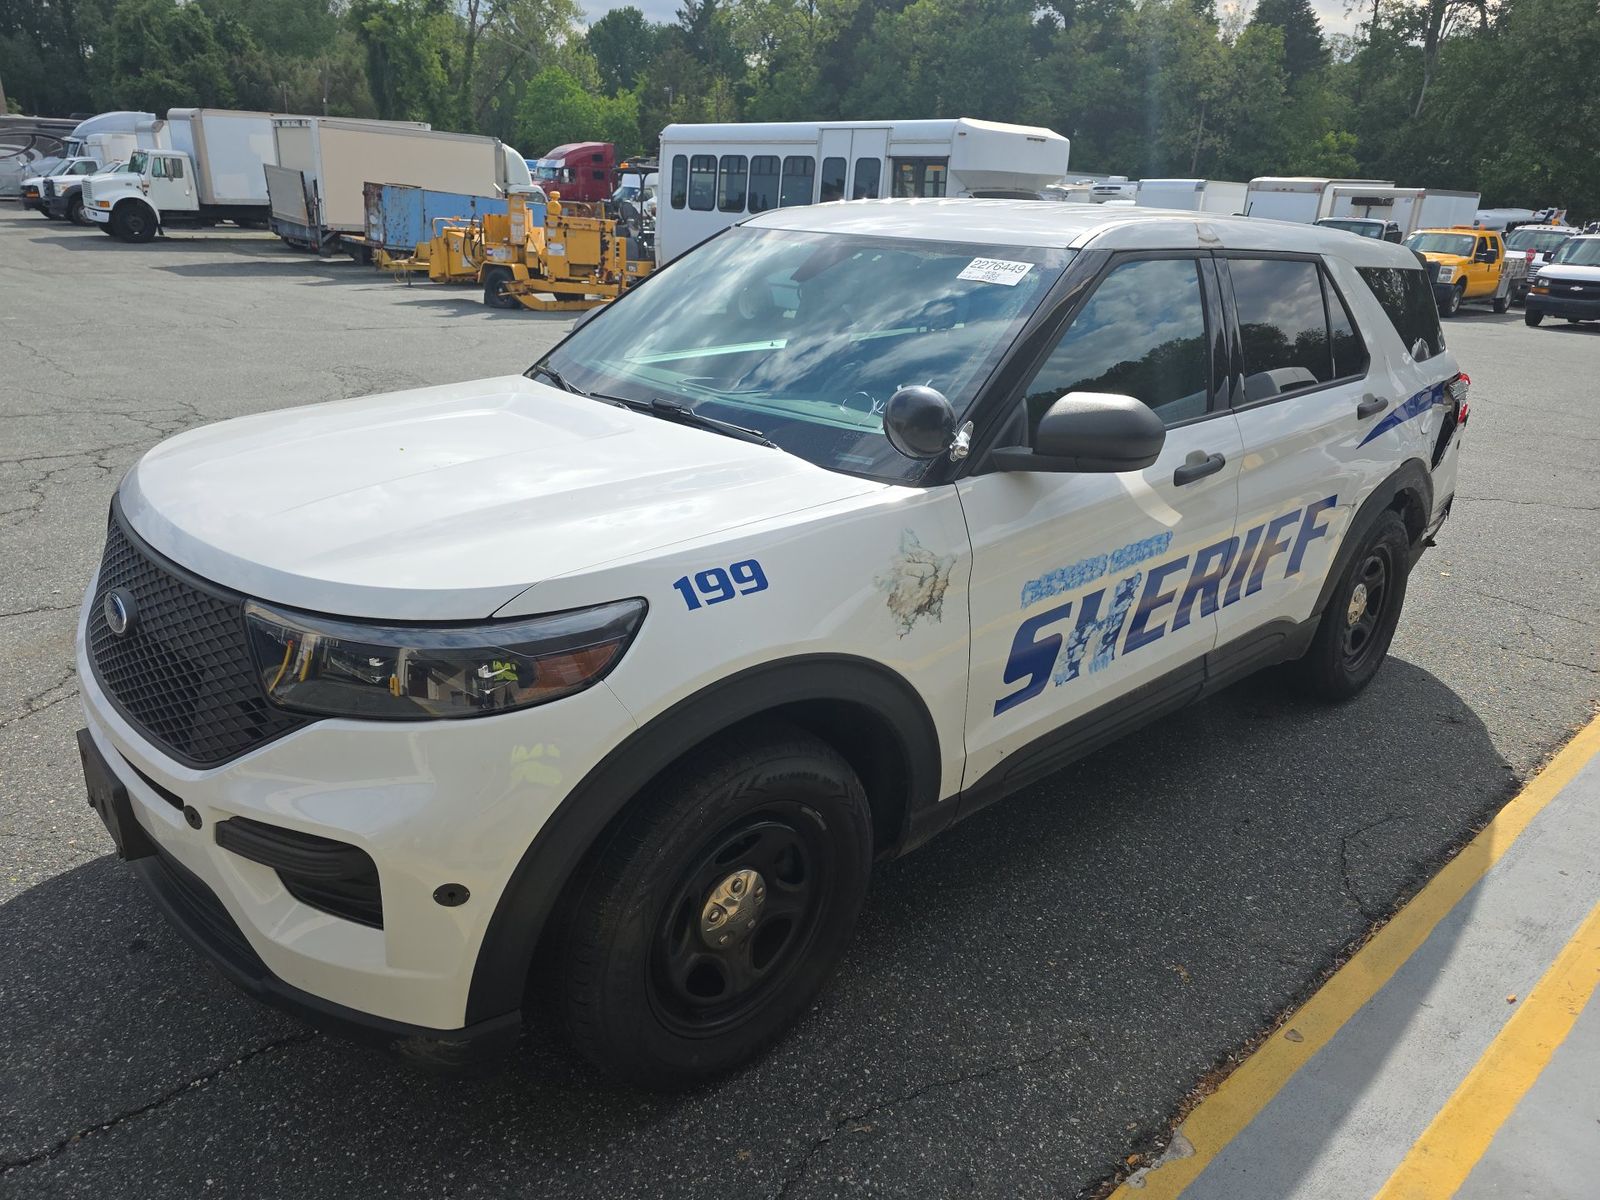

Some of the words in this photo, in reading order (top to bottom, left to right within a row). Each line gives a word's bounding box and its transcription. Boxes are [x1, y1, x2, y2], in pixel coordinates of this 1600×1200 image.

[970, 259, 1026, 274] 2276449
[673, 559, 769, 611] 199
[993, 494, 1338, 717] SHERIFF
